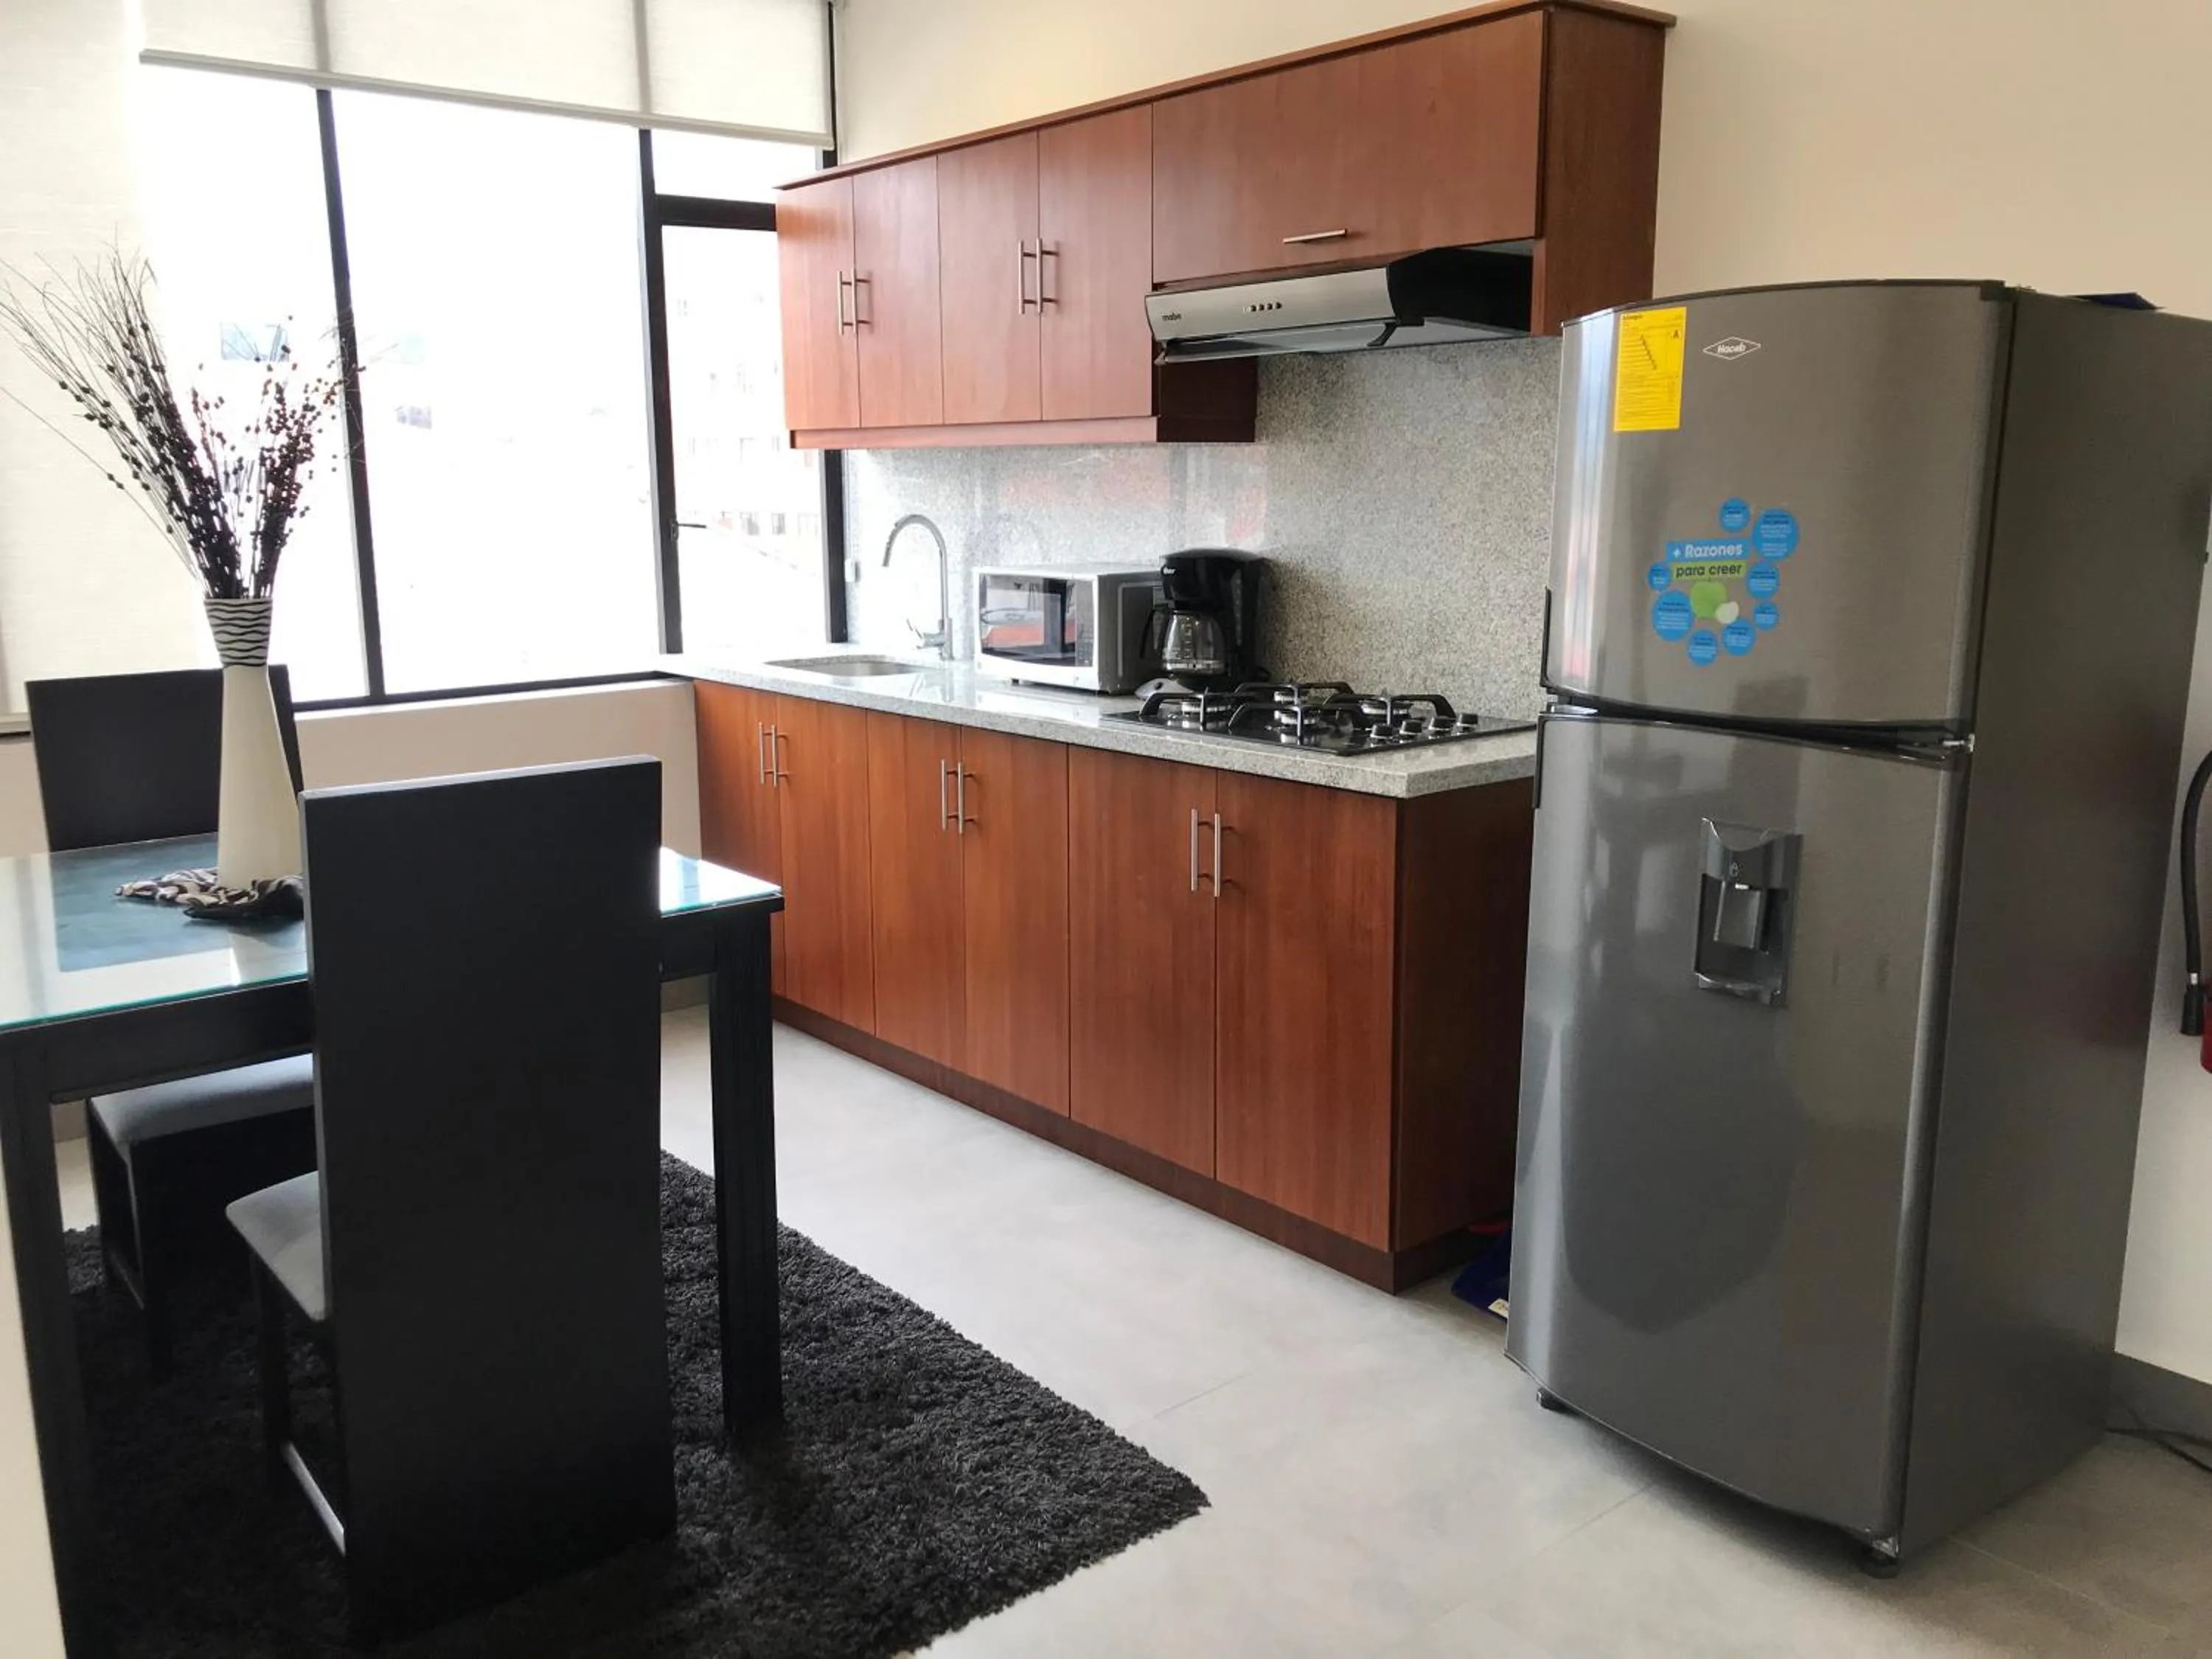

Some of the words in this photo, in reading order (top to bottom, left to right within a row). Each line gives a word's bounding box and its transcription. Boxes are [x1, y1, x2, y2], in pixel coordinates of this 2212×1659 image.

[1684, 543, 1743, 558] Razones
[1675, 565, 1705, 578] para
[1708, 563, 1742, 576] creer
